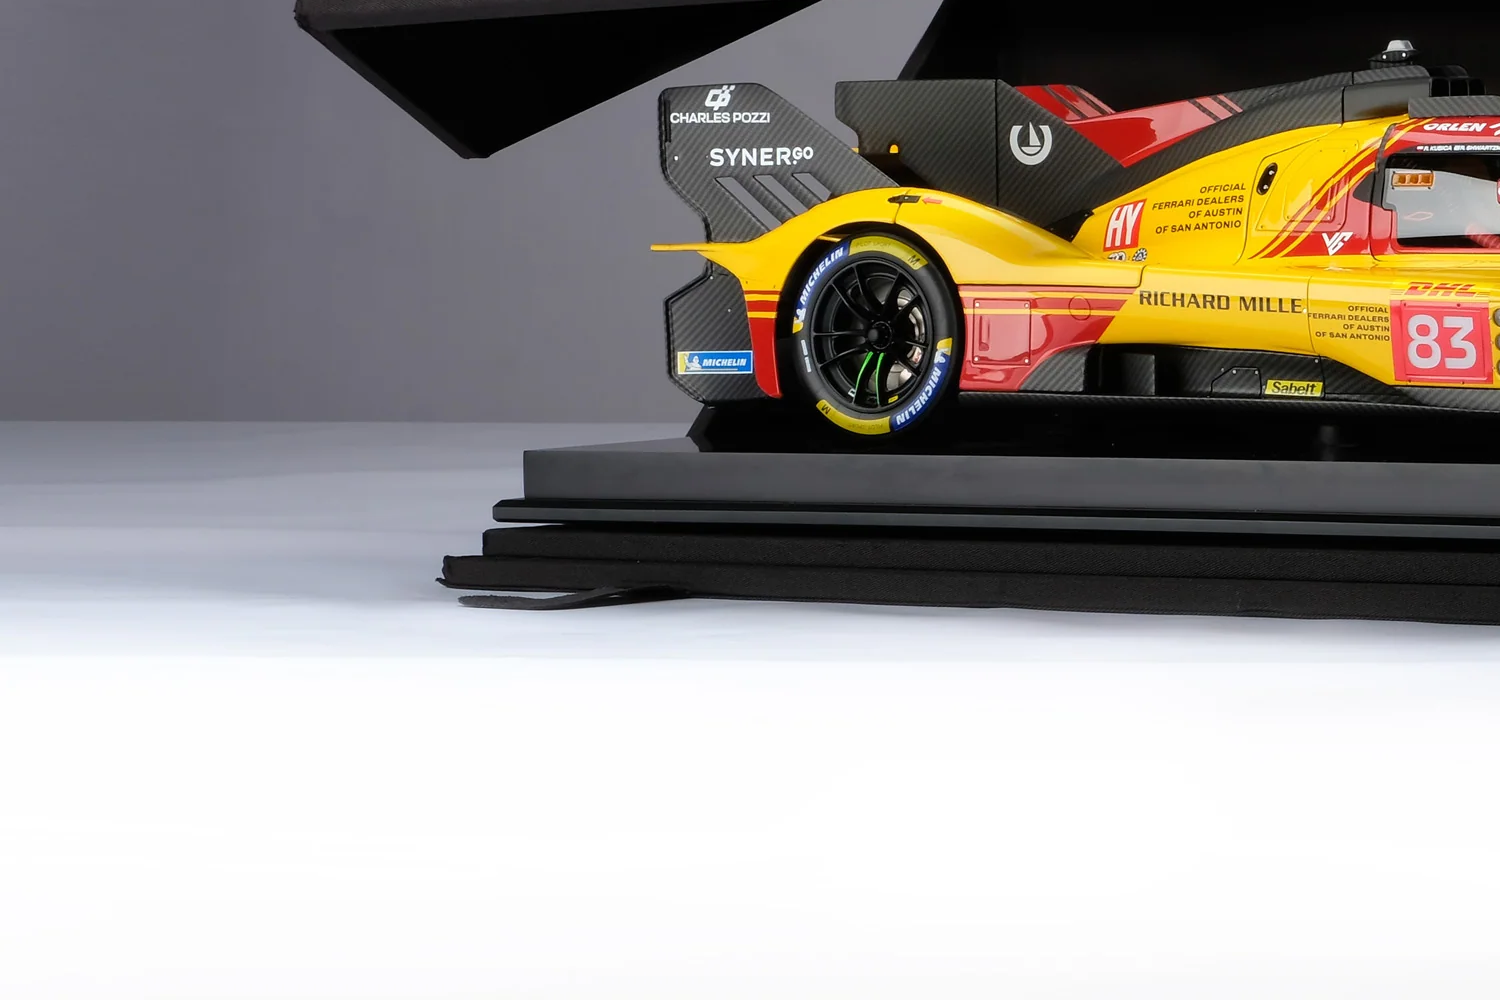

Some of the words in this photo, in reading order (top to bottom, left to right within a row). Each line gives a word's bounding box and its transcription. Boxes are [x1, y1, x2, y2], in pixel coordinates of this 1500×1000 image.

[670, 112, 731, 124] CHARLES
[733, 112, 771, 124] POZZI
[1423, 122, 1487, 133] ORLEN
[1200, 183, 1247, 194] OFFICIAL
[1152, 199, 1195, 211] FERRARI
[1197, 195, 1245, 206] DEALERS
[1188, 210, 1203, 219] OF
[1204, 207, 1243, 218] AUSTIN
[1105, 202, 1145, 248] HY
[1155, 226, 1168, 235] OF
[1171, 223, 1191, 233] SAN
[1194, 220, 1242, 231] ANTONIO
[908, 254, 921, 266] M
[799, 246, 845, 306] MICHELIN
[1404, 282, 1477, 297] DHL
[1139, 290, 1230, 311] RICHARD
[1239, 296, 1303, 314] MILLE
[1348, 305, 1389, 314] OFFICIAL
[1308, 312, 1346, 321] FERRARI
[1348, 314, 1390, 323] DEALERS
[1356, 324, 1390, 333] AUSTIN
[1349, 333, 1390, 342] ANTONIO
[1407, 314, 1477, 369] 83
[702, 358, 747, 367] MICHELIN
[1271, 381, 1318, 396] Sabelt
[896, 366, 942, 426] MICHELIN
